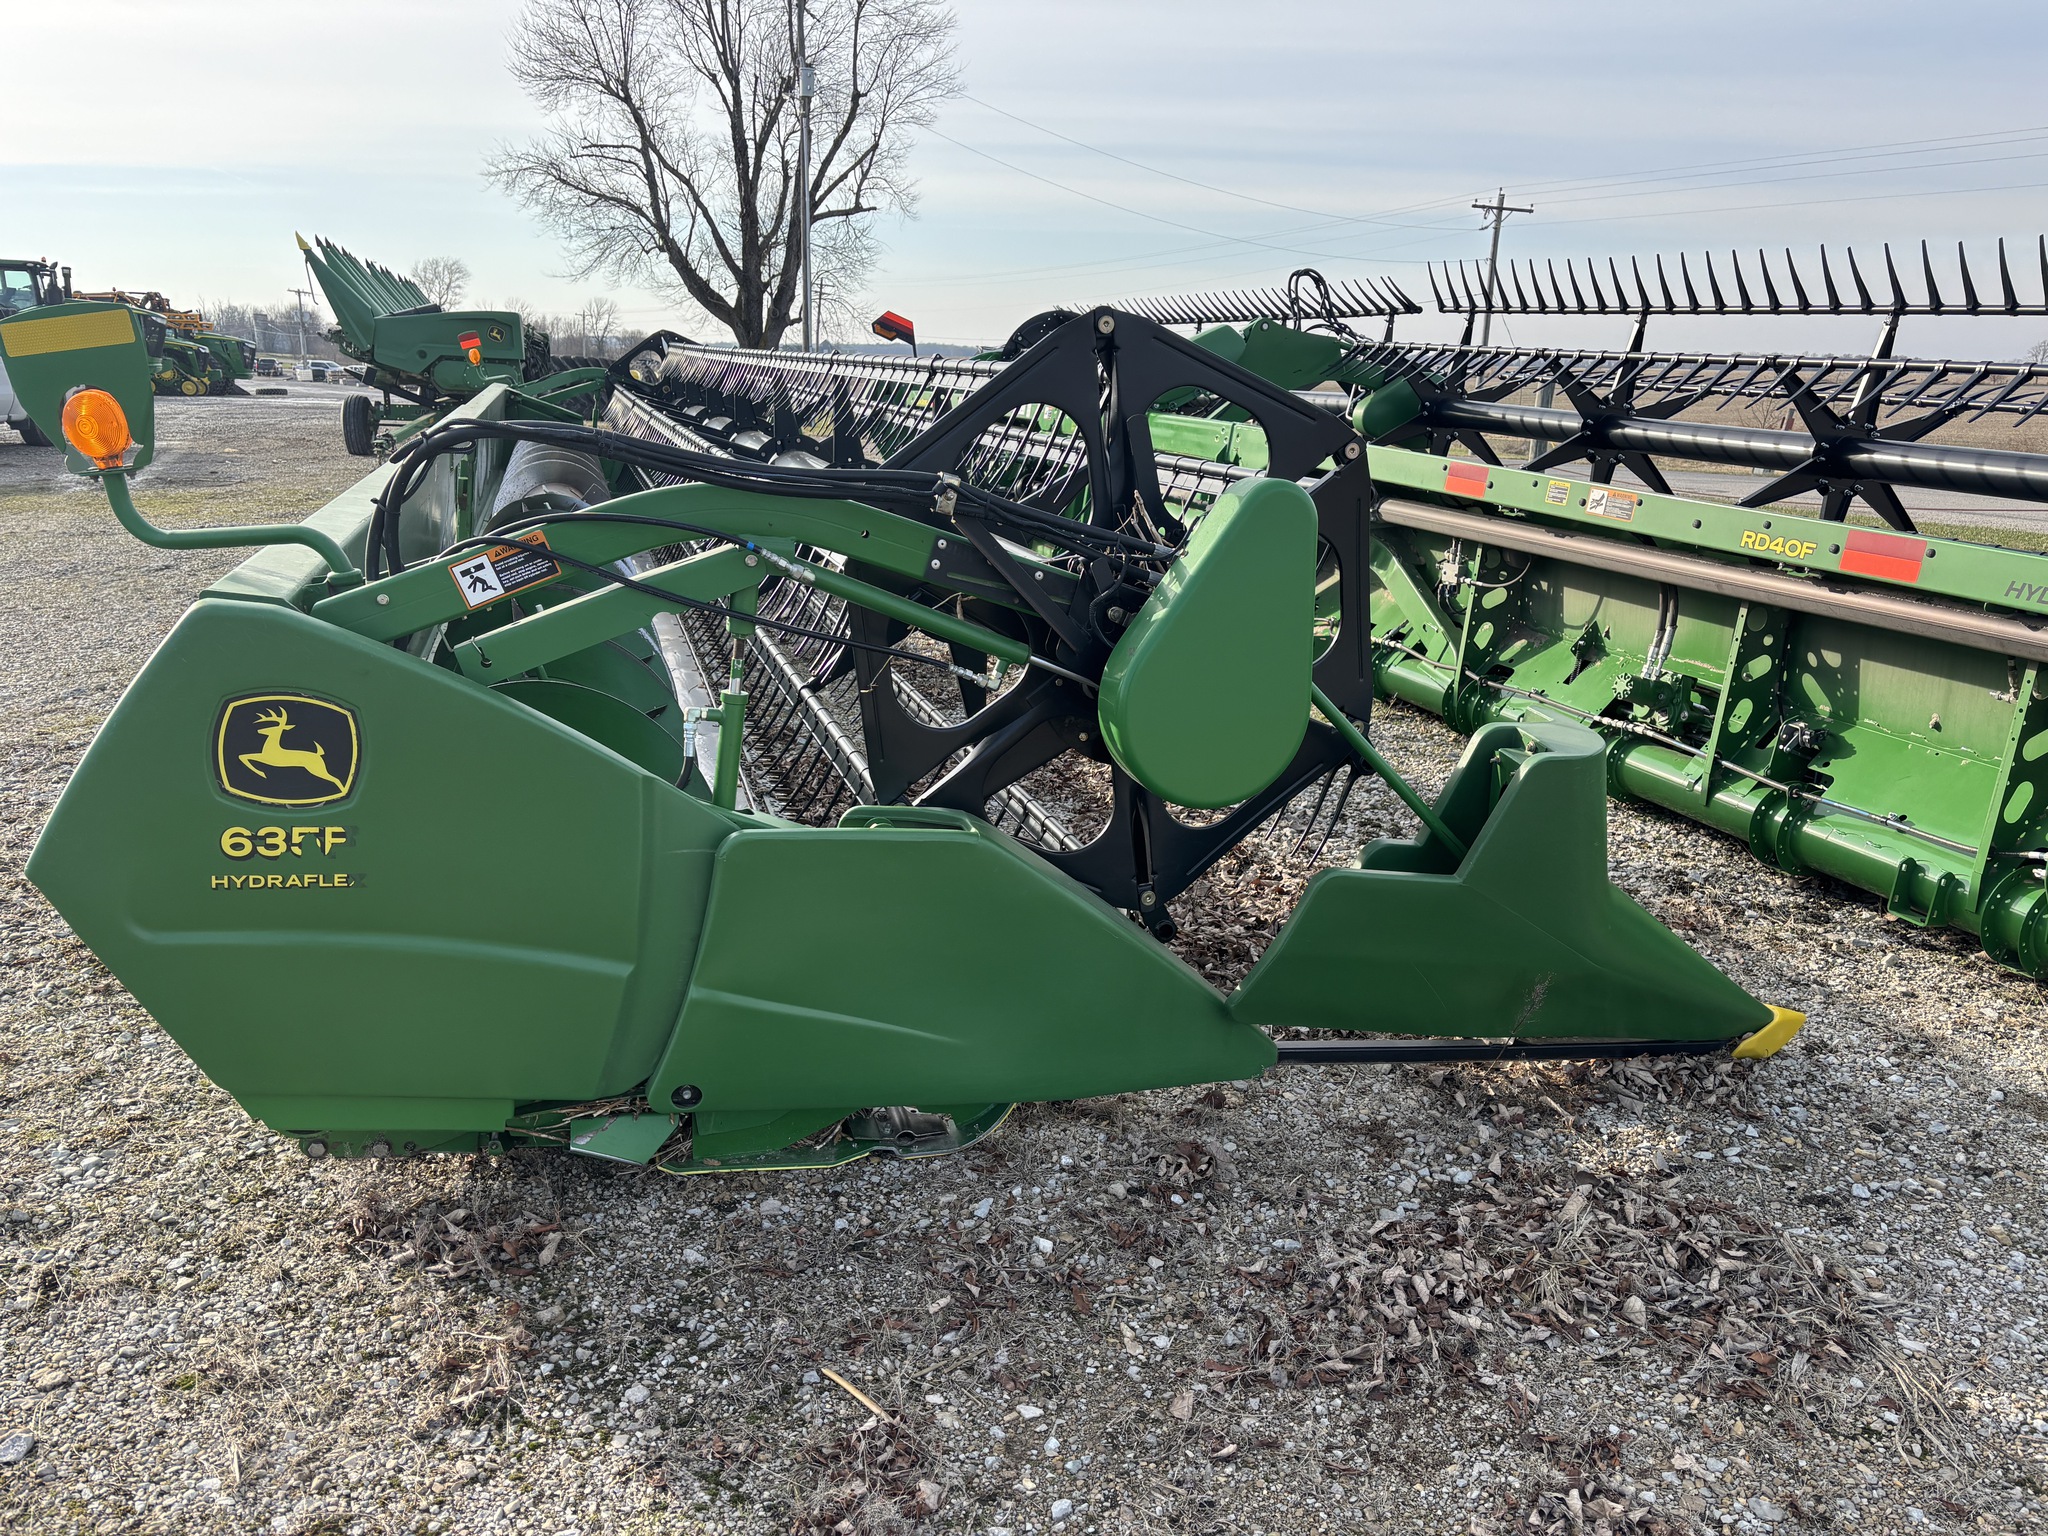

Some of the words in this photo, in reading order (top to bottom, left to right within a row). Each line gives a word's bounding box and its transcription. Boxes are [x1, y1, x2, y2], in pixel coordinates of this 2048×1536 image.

[499, 535, 539, 555] WAING
[1740, 529, 1818, 560] RD40F
[210, 873, 358, 890] HYDRAFLE
